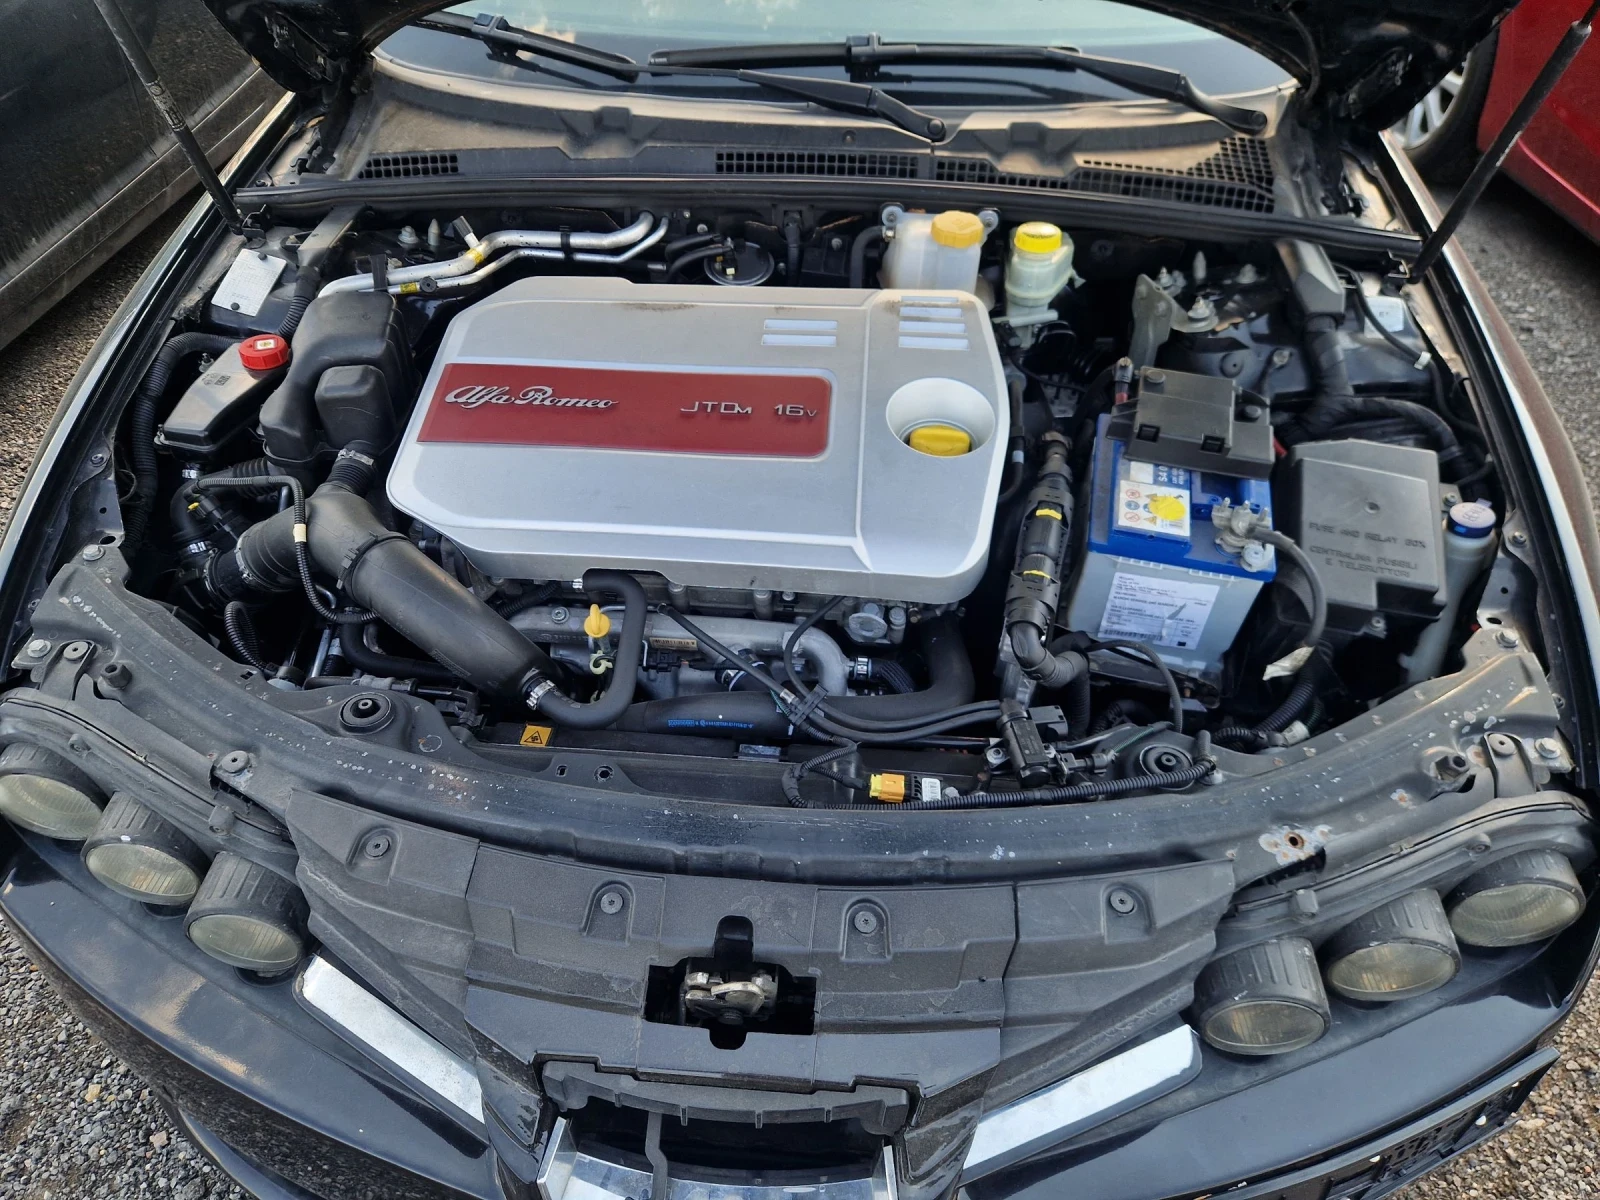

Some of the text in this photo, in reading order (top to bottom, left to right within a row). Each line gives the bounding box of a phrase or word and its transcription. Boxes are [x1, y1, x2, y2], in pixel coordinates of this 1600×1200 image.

[444, 385, 618, 409] Alfa Romeo
[1308, 522, 1427, 549] FUSE AND RELAY BOX
[1309, 545, 1418, 571] CENTRALINA FUSIBILI
[1325, 557, 1411, 579] E TELERUTTORI
